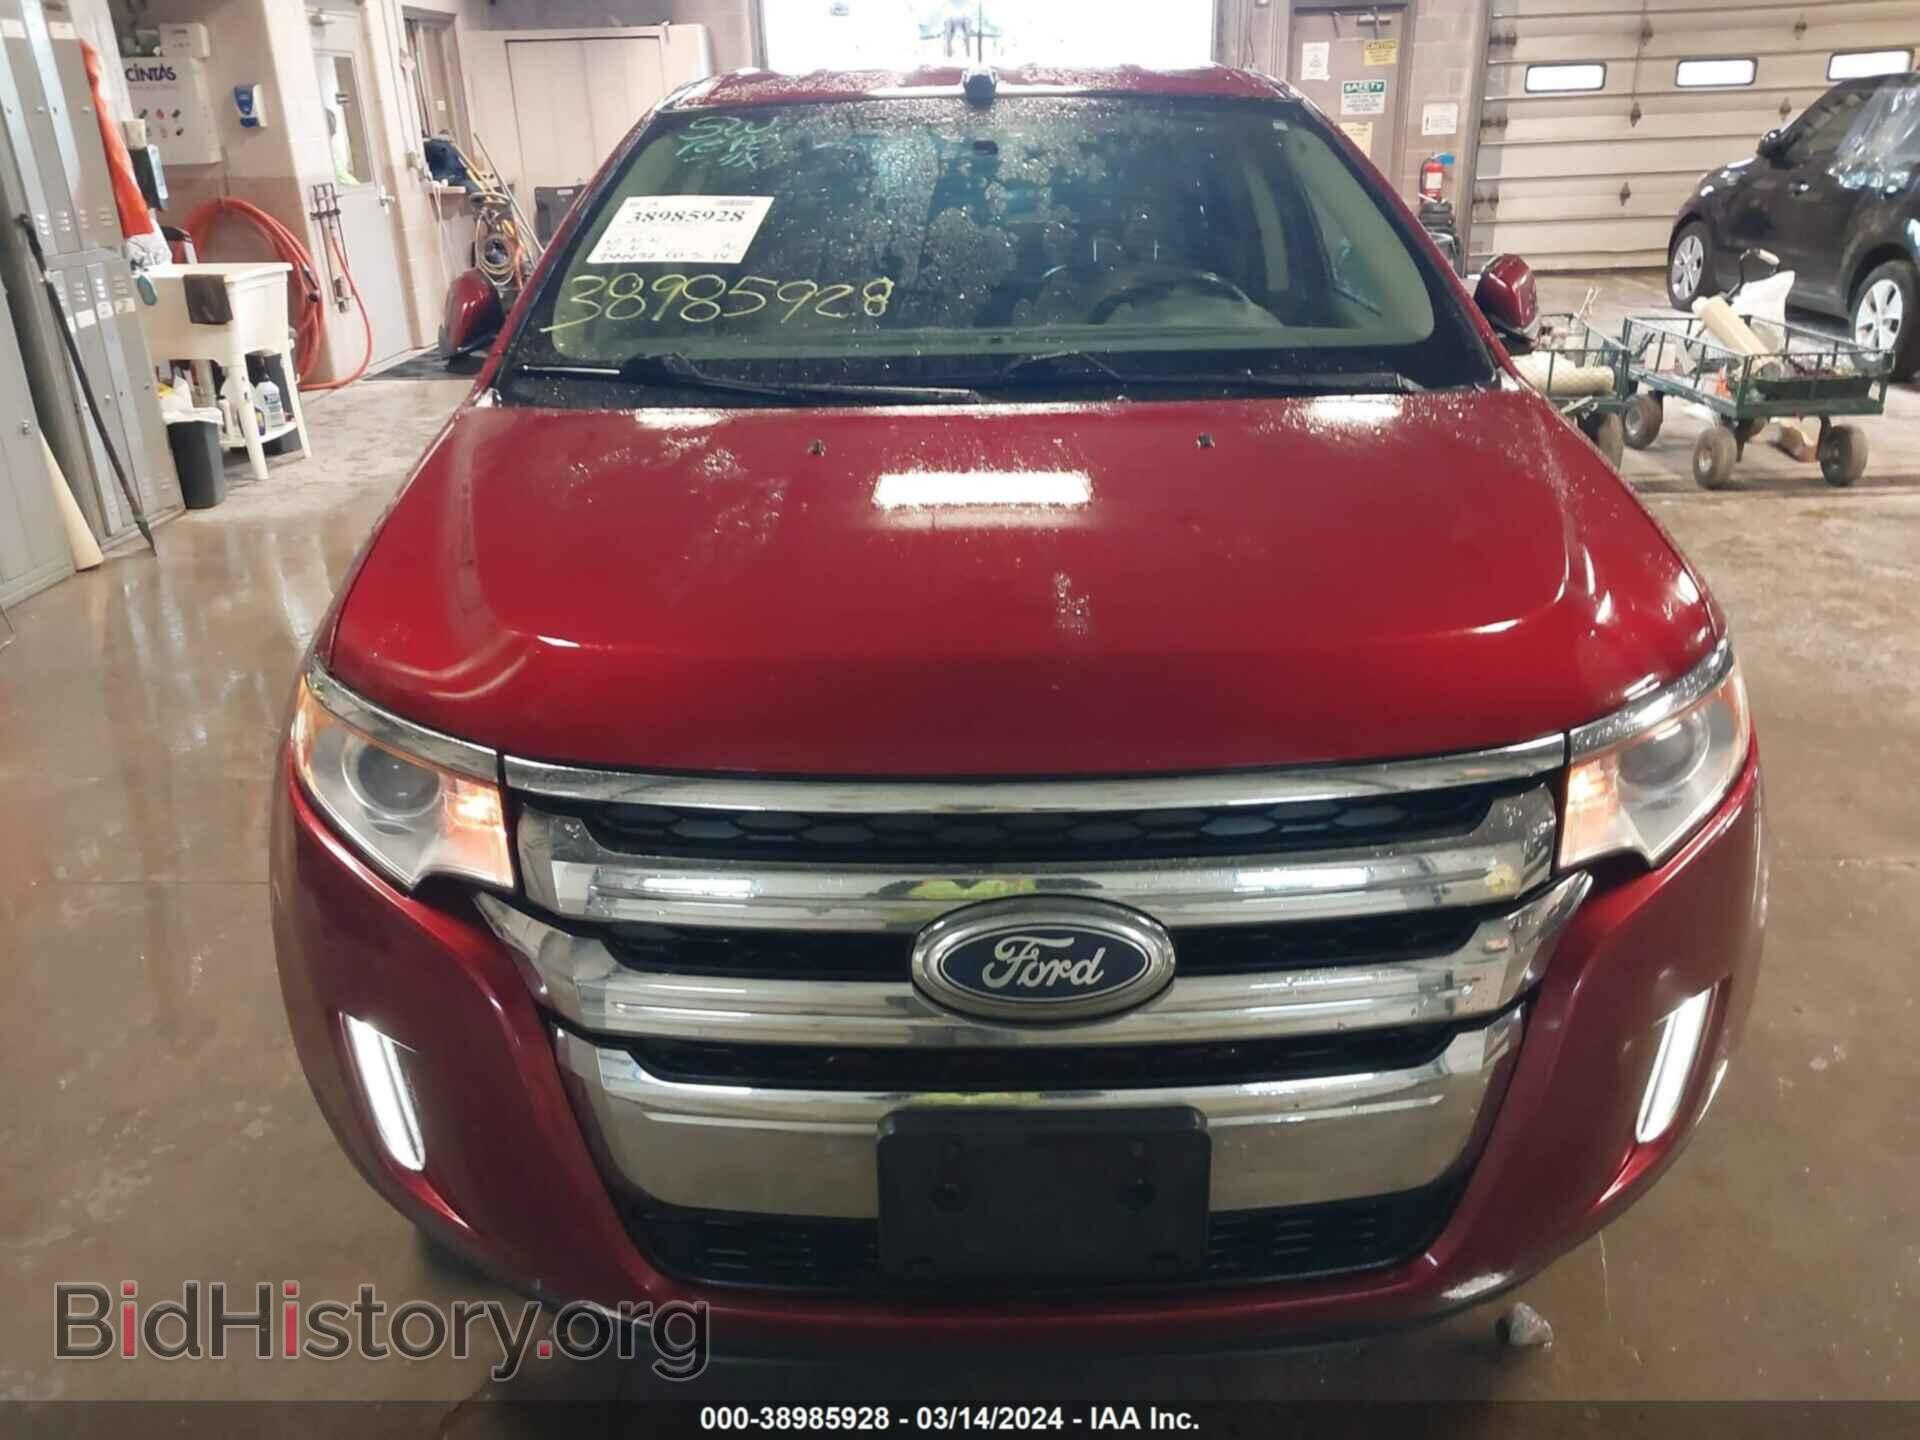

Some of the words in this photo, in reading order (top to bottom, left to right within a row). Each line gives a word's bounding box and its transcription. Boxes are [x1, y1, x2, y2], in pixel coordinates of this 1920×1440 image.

[626, 209, 745, 224] 38985928
[539, 272, 895, 333] 38985928
[982, 936, 1106, 988] Ford
